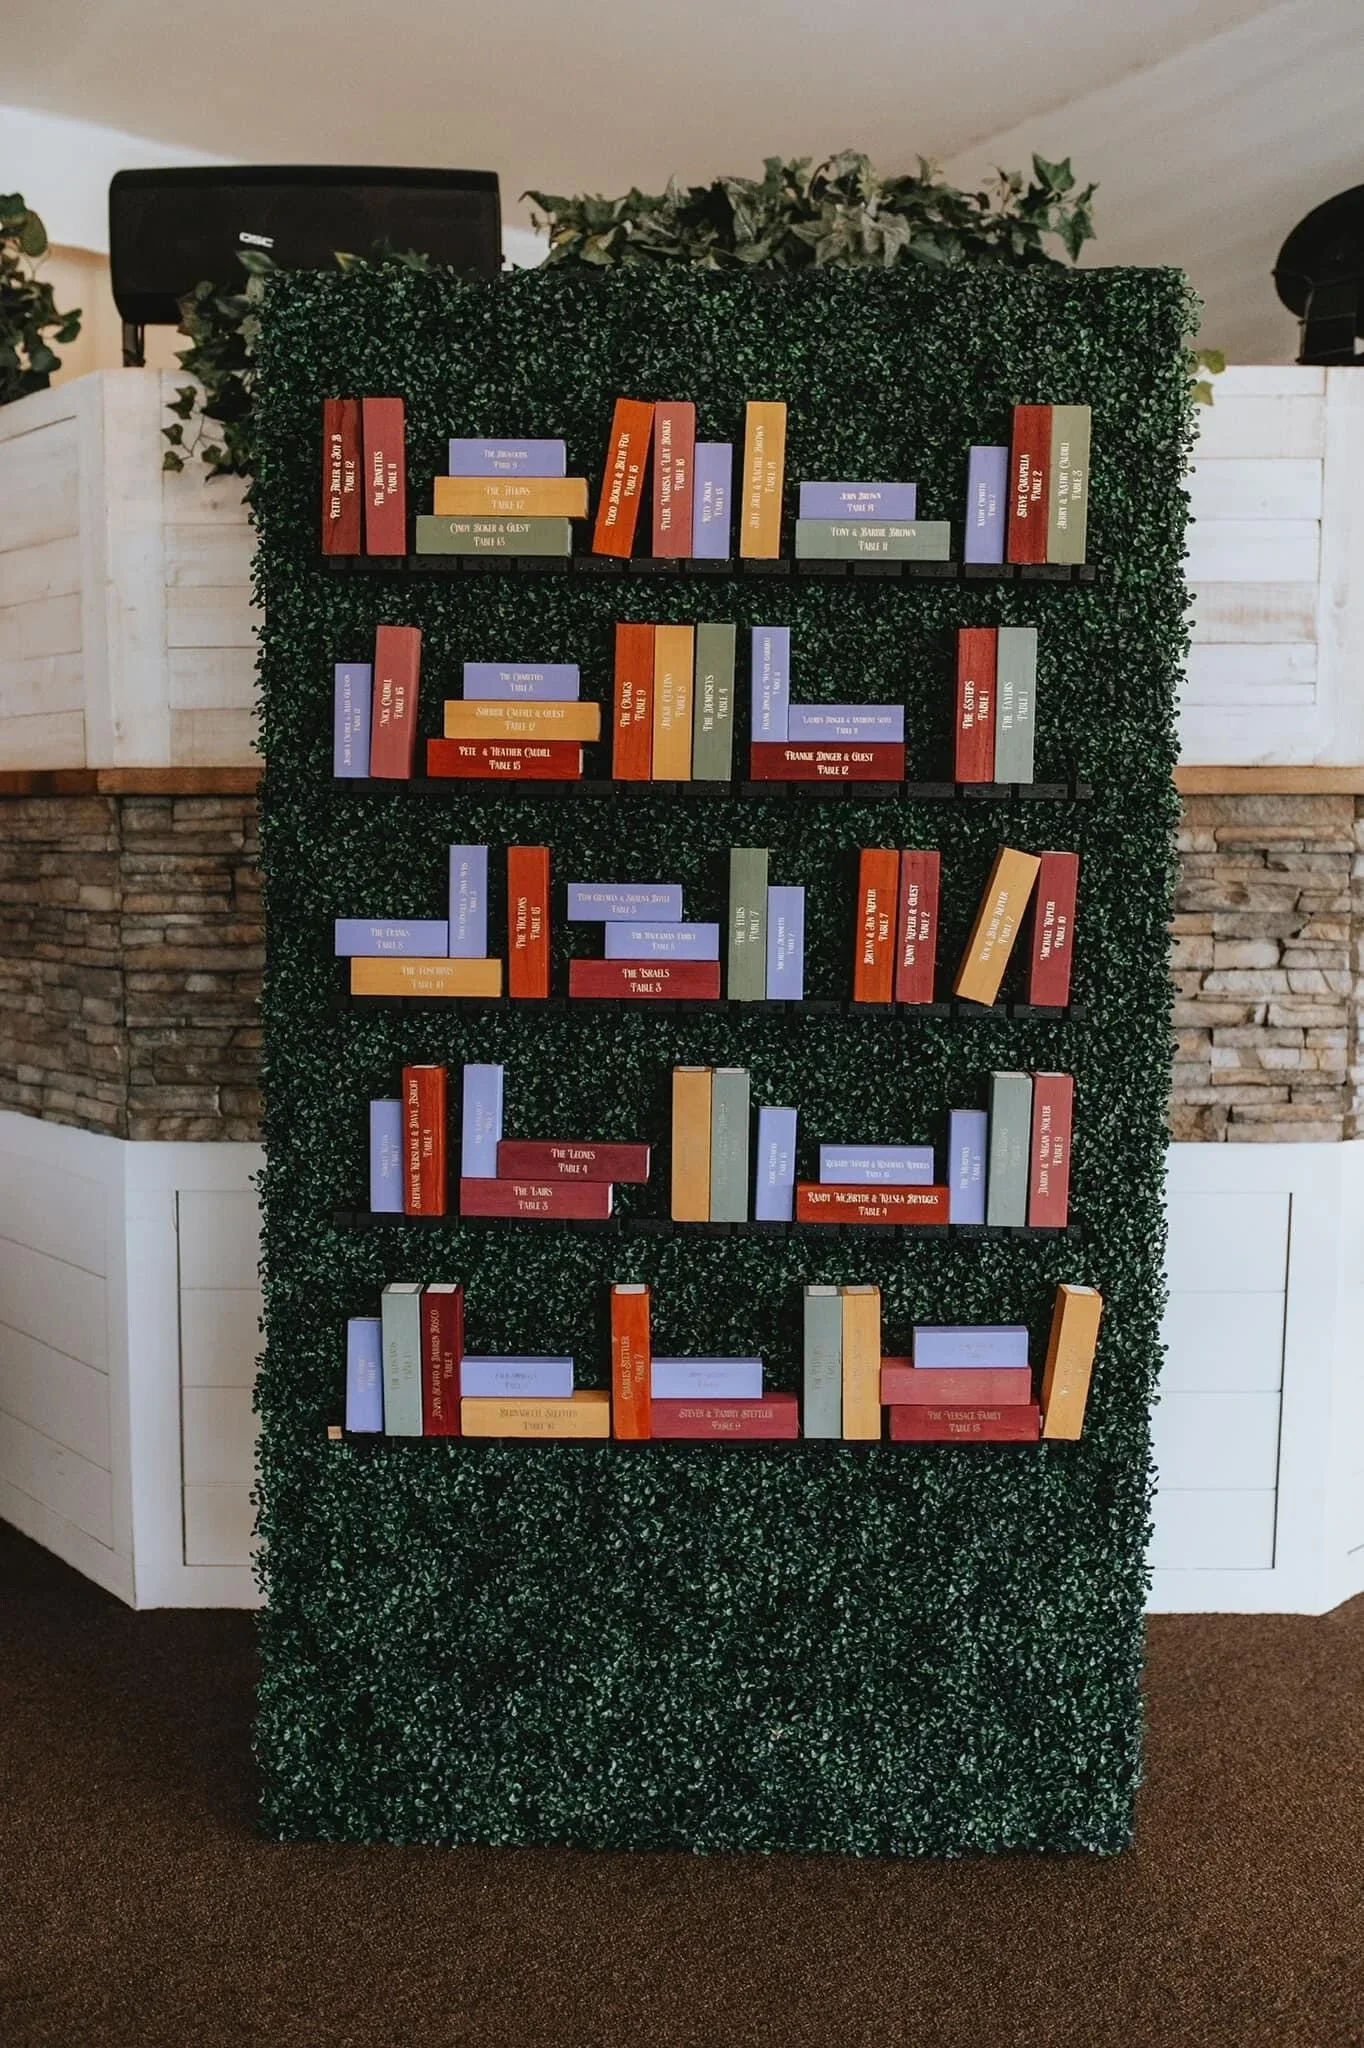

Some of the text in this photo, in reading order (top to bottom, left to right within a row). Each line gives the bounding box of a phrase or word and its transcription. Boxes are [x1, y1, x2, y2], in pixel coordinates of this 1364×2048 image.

[618, 431, 631, 449] FOX
[330, 444, 342, 460] JOY
[614, 449, 628, 472] BETH
[661, 448, 672, 466] LILY
[330, 469, 342, 495] ADLER
[344, 460, 355, 493] TABLE 12
[373, 451, 385, 506] THE ARNETTES
[387, 471, 398, 494] TABLE
[624, 473, 637, 497] TABLE
[674, 467, 685, 491] TABLE
[764, 471, 777, 494] TABLE
[1016, 454, 1031, 518] STEVE CARAPELLA
[1057, 472, 1069, 497] KATHY
[661, 474, 672, 506] MARISA
[1030, 478, 1042, 501] TABLE
[1071, 477, 1082, 501] TABLE
[330, 496, 342, 519] PETEY
[490, 499, 514, 510] TABLE
[605, 504, 618, 527] TODD
[450, 521, 470, 534] CINDY
[498, 522, 504, 535] &
[506, 522, 531, 535] GUEST
[660, 507, 672, 531] TYLER
[1056, 506, 1068, 529] JERRY
[473, 536, 495, 547] TABLE
[830, 526, 850, 537] TONY
[852, 528, 857, 537] &
[888, 527, 917, 538] BROWN
[857, 540, 881, 552] TABLE
[393, 698, 405, 720] TABLE
[620, 681, 633, 728] THE CRAIGS
[635, 697, 646, 722] TABLE
[675, 695, 686, 718] TABLE
[702, 674, 715, 732] THE DEMPSEYS
[717, 696, 729, 719] TABLE
[961, 680, 975, 730] THE ESTEPS
[977, 697, 989, 721] TABLE
[1016, 697, 1029, 722] TABLE
[504, 720, 526, 731] TABLE
[1001, 714, 1013, 731] THE
[458, 746, 551, 759] PETE & HEATHER CAUDILL
[784, 750, 874, 762] FRANKIE DINGER & GUEST
[489, 759, 511, 771] TABLE
[817, 764, 840, 775] TABLE
[907, 883, 919, 907] GUEST
[516, 896, 528, 948] THE HOLTONS
[530, 917, 541, 940] TABLE
[749, 919, 760, 942] TABLE
[878, 919, 889, 942] TABLE
[918, 919, 930, 942] TABLE
[1039, 900, 1056, 961] MICHAEL KEPLER
[1054, 915, 1067, 949] TABLE 10
[734, 930, 745, 945] THE
[863, 939, 876, 965] BRYAN
[622, 968, 671, 979] THE ISRAELS
[630, 982, 662, 993] TABLE 3
[409, 1109, 420, 1129] DAVE
[410, 1137, 421, 1172] KERSLAKE
[422, 1135, 433, 1158] TABLE
[550, 1148, 596, 1160] THE LEONES
[1039, 1135, 1051, 1161] MEGAN
[1052, 1143, 1063, 1167] TABLE
[558, 1163, 580, 1174] TABLE
[411, 1173, 422, 1208] STEPHANIE
[512, 1185, 528, 1197] THE
[1038, 1170, 1050, 1197] AARON
[518, 1200, 541, 1211] TABLE
[807, 1191, 831, 1204] RANDY
[871, 1194, 878, 1203] &
[857, 1206, 881, 1217] TABLE
[430, 1309, 441, 1334] BOSCO
[431, 1335, 441, 1363] DARREN
[444, 1359, 454, 1379] TABLE
[634, 1360, 645, 1383] TABLE
[621, 1369, 633, 1400] CHARLES
[679, 1407, 712, 1419] STEVEN &
[927, 1411, 942, 1421] THE
[711, 1421, 734, 1431] TABLE
[948, 1423, 969, 1433] TABLE
